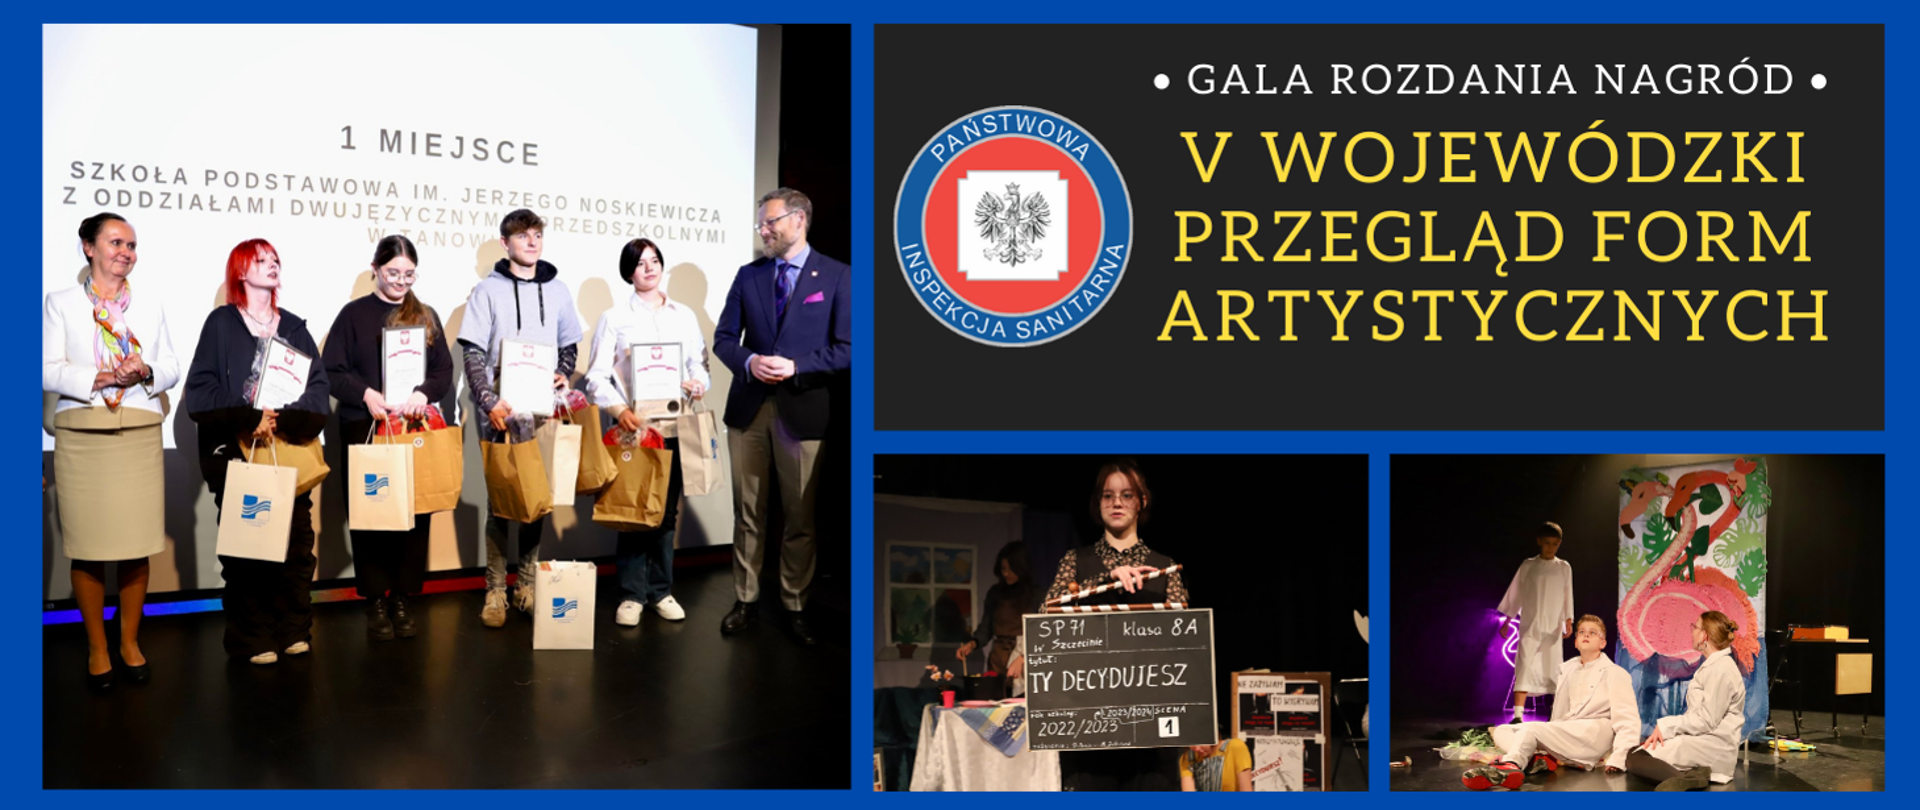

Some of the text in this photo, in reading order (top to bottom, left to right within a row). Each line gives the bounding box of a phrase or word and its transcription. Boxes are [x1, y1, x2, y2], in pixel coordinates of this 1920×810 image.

[340, 125, 539, 167] 1 MIEJSCE
[70, 161, 721, 224] SZKOŁA PODSTAWOWA IM. JERZEGO NOSKIEWICZA
[63, 187, 77, 205] Z
[94, 188, 274, 214] ODDZIAŁAMI
[290, 199, 507, 228] DWUJĘZYCZNYM
[1038, 618, 1085, 638] SP 71
[1122, 621, 1163, 637] klasa
[1028, 663, 1188, 693] TY DECYDUJESZ
[1037, 718, 1119, 739] 2022/2023
[1165, 719, 1173, 734] 1
